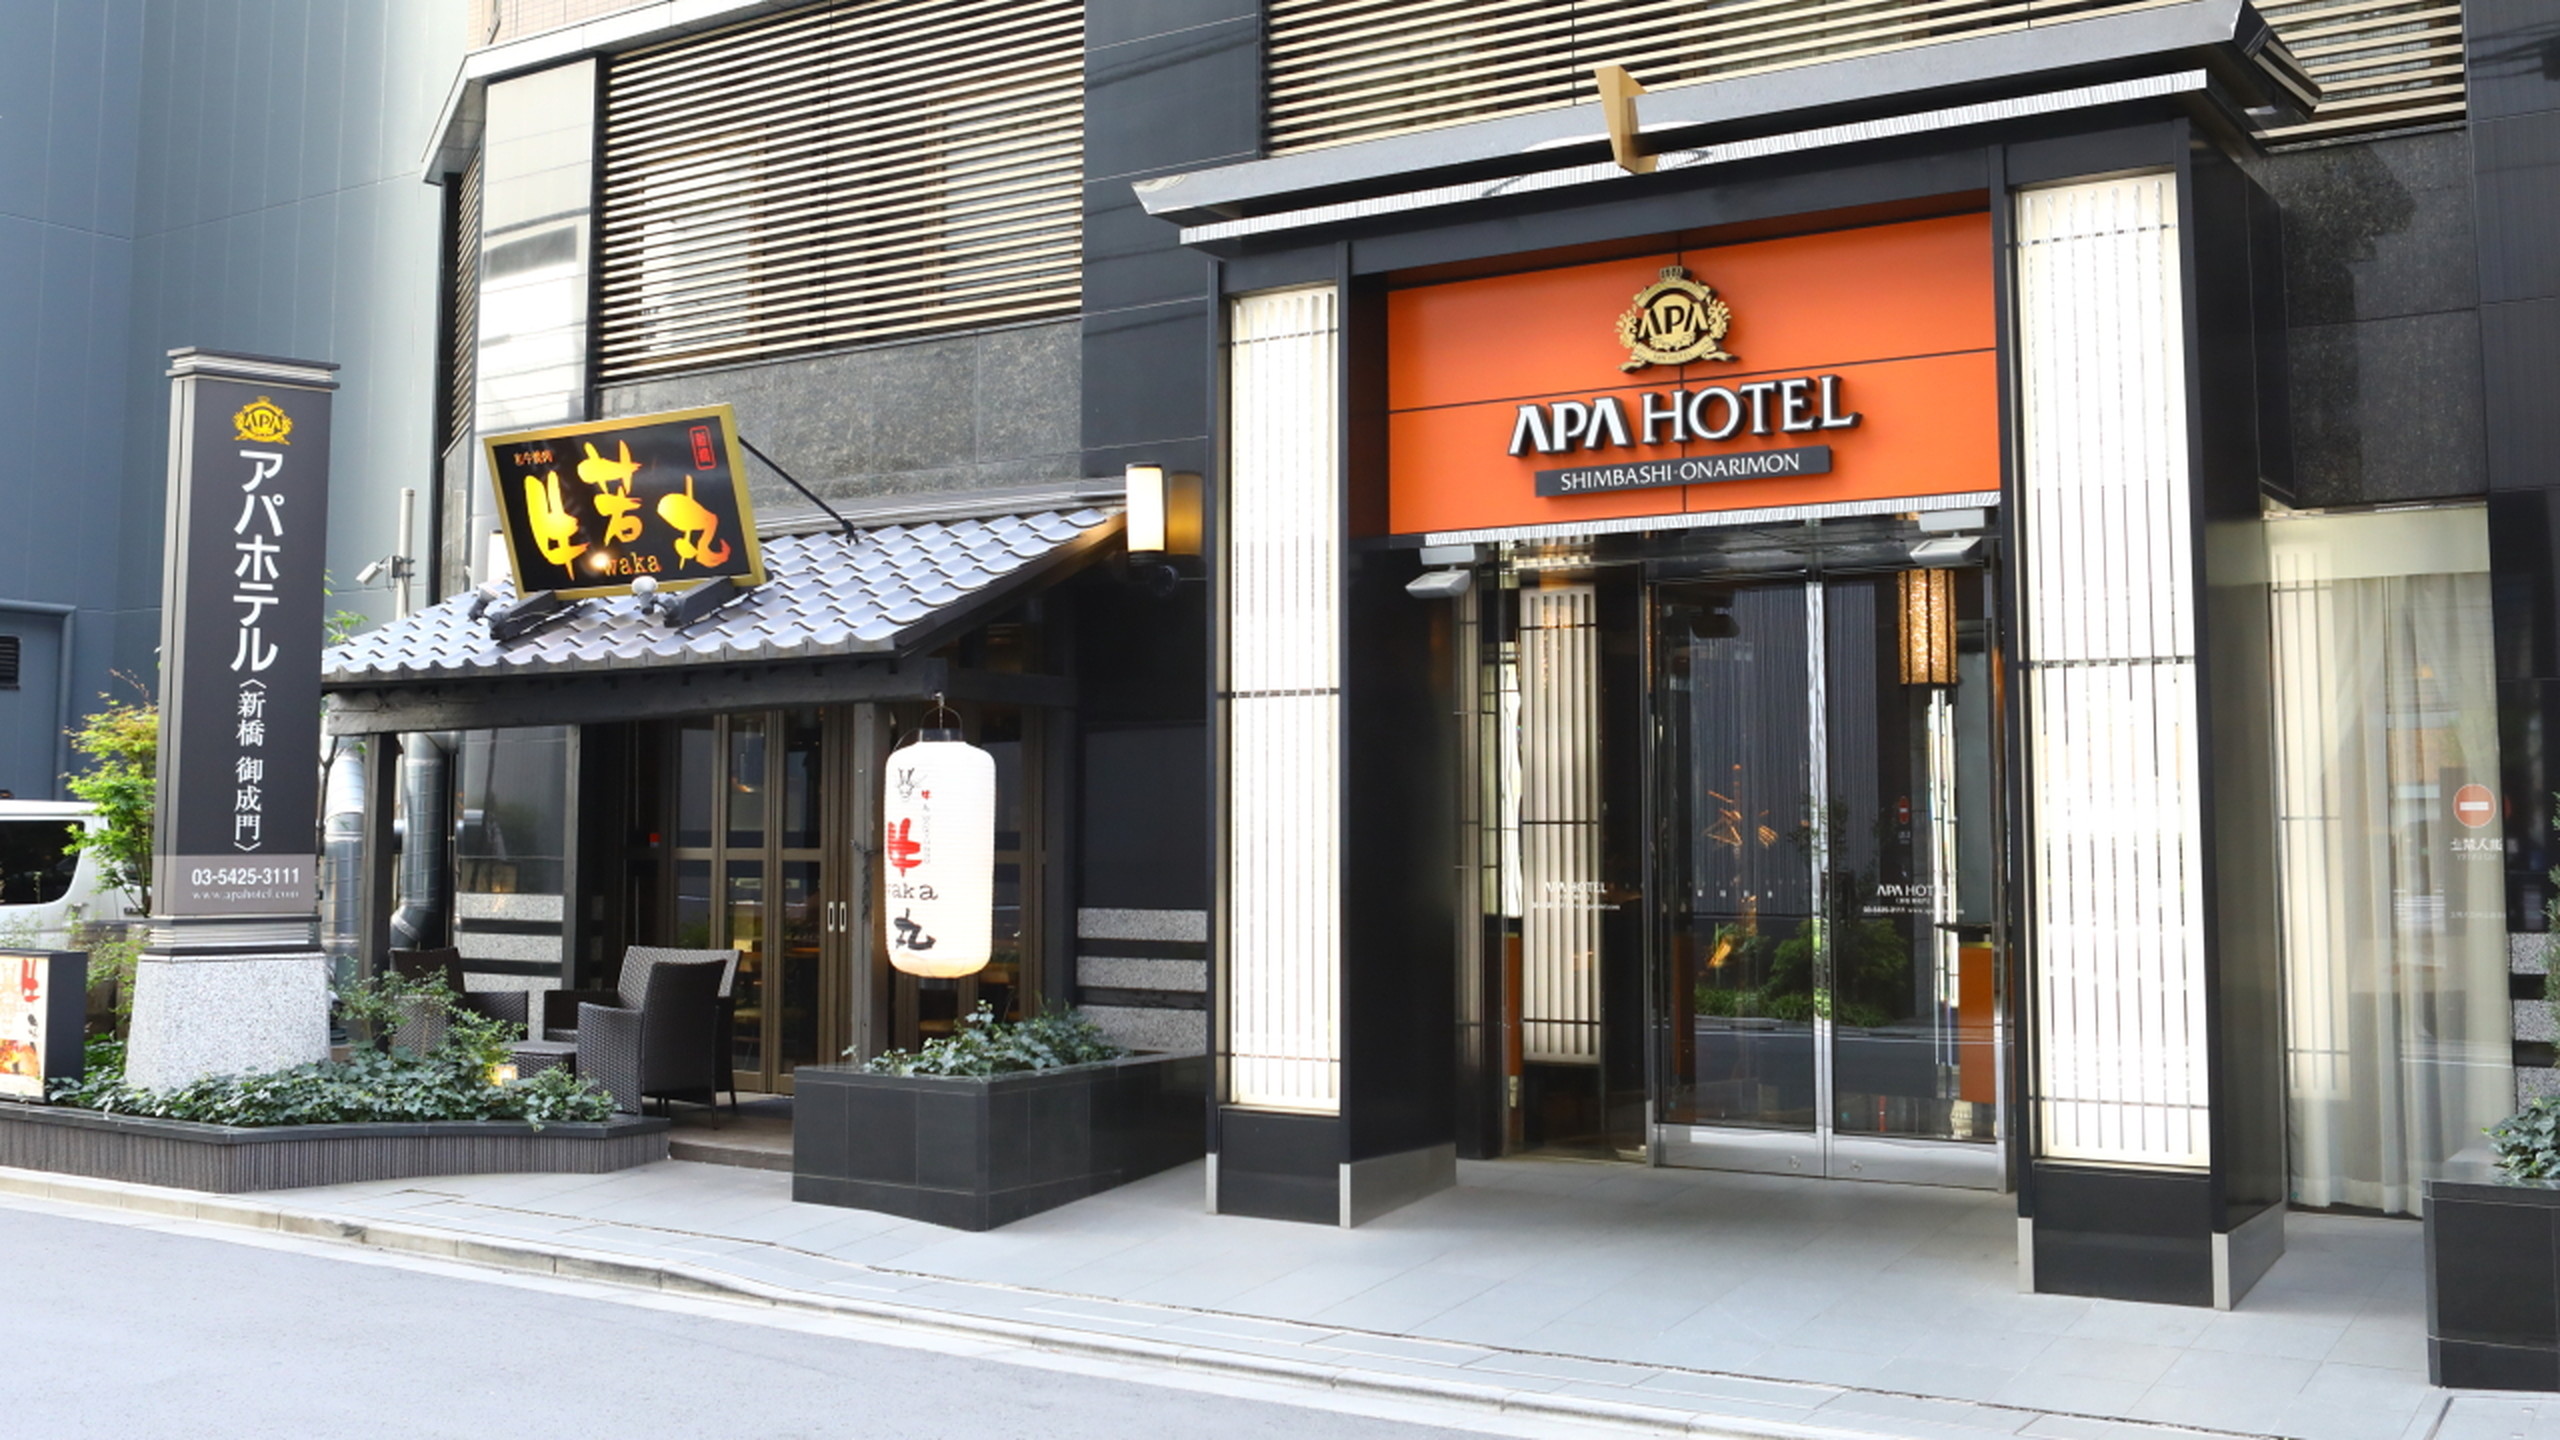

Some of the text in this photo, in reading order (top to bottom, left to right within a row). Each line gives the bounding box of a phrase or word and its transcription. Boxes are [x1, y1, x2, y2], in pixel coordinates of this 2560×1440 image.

[1638, 304, 1708, 339] APA
[1509, 374, 1862, 456] APA HOTEL
[230, 450, 285, 672] アパホテル
[192, 867, 299, 885] 03-5425-3111
[1877, 884, 1903, 896] APA
